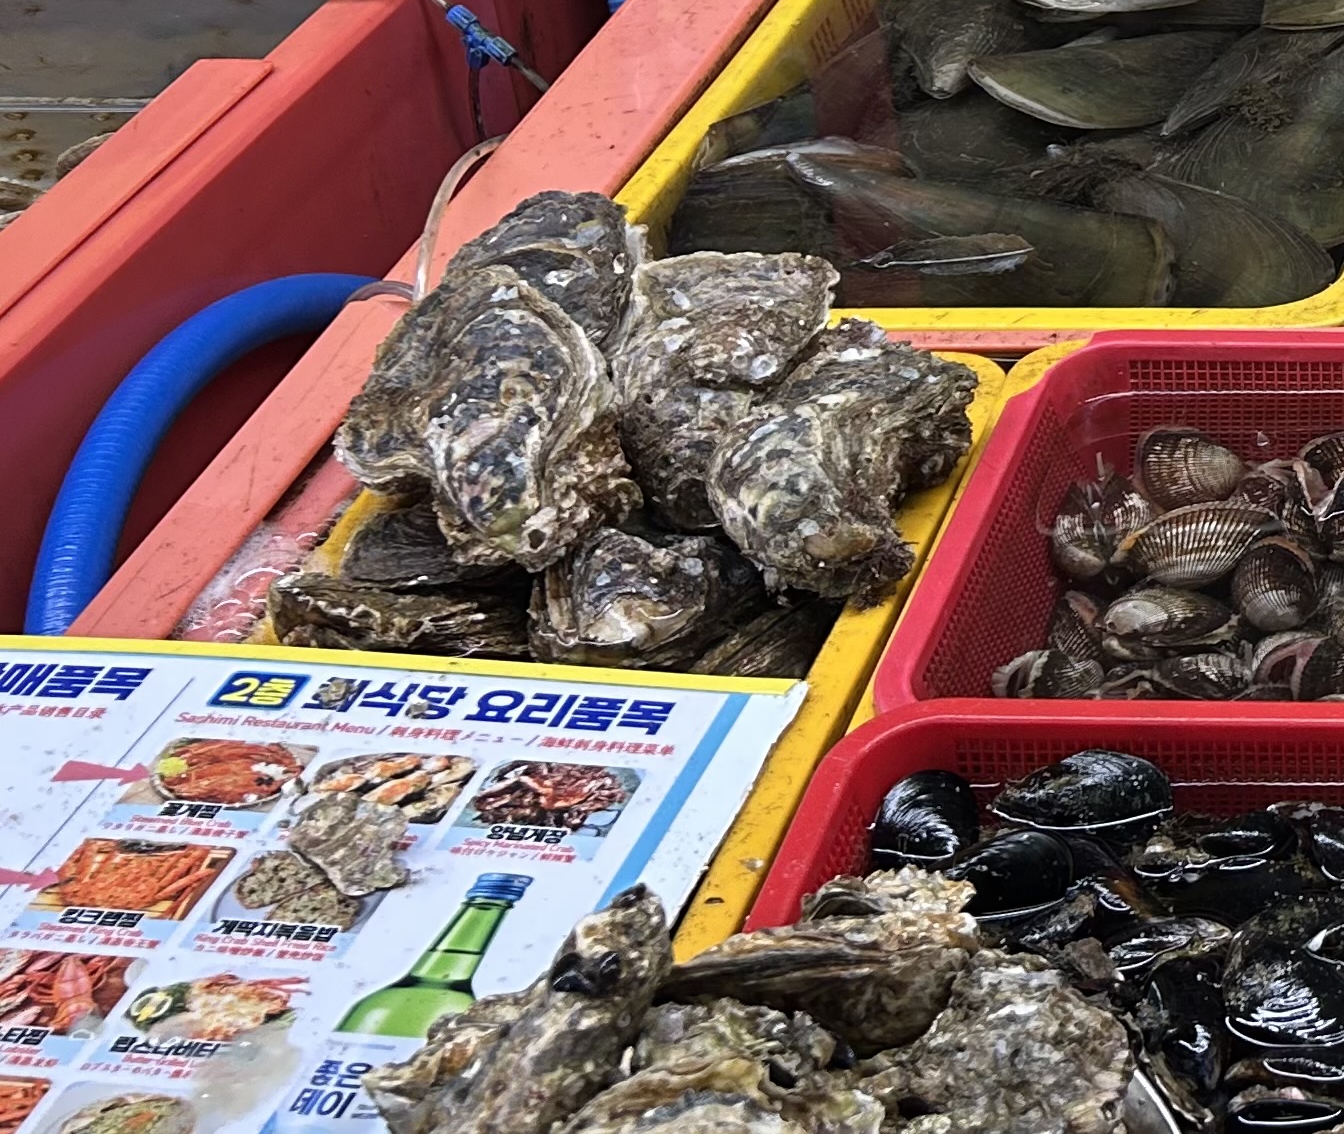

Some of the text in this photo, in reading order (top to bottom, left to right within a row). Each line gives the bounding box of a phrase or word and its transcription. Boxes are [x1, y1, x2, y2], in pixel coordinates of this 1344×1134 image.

[0, 662, 153, 701] 매품목
[220, 677, 296, 706] 2층
[463, 689, 677, 736] 요리품목
[174, 711, 240, 726] Sashimi
[241, 715, 329, 732] Restaurant
[331, 722, 376, 735] Menu
[461, 837, 490, 848] Spicy
[548, 844, 576, 853] Crab
[486, 825, 567, 845] 양념게장
[58, 908, 145, 928] 킹크랩찜
[211, 919, 339, 943] 게딱지볶음밥
[0, 1027, 49, 1045] 타찜
